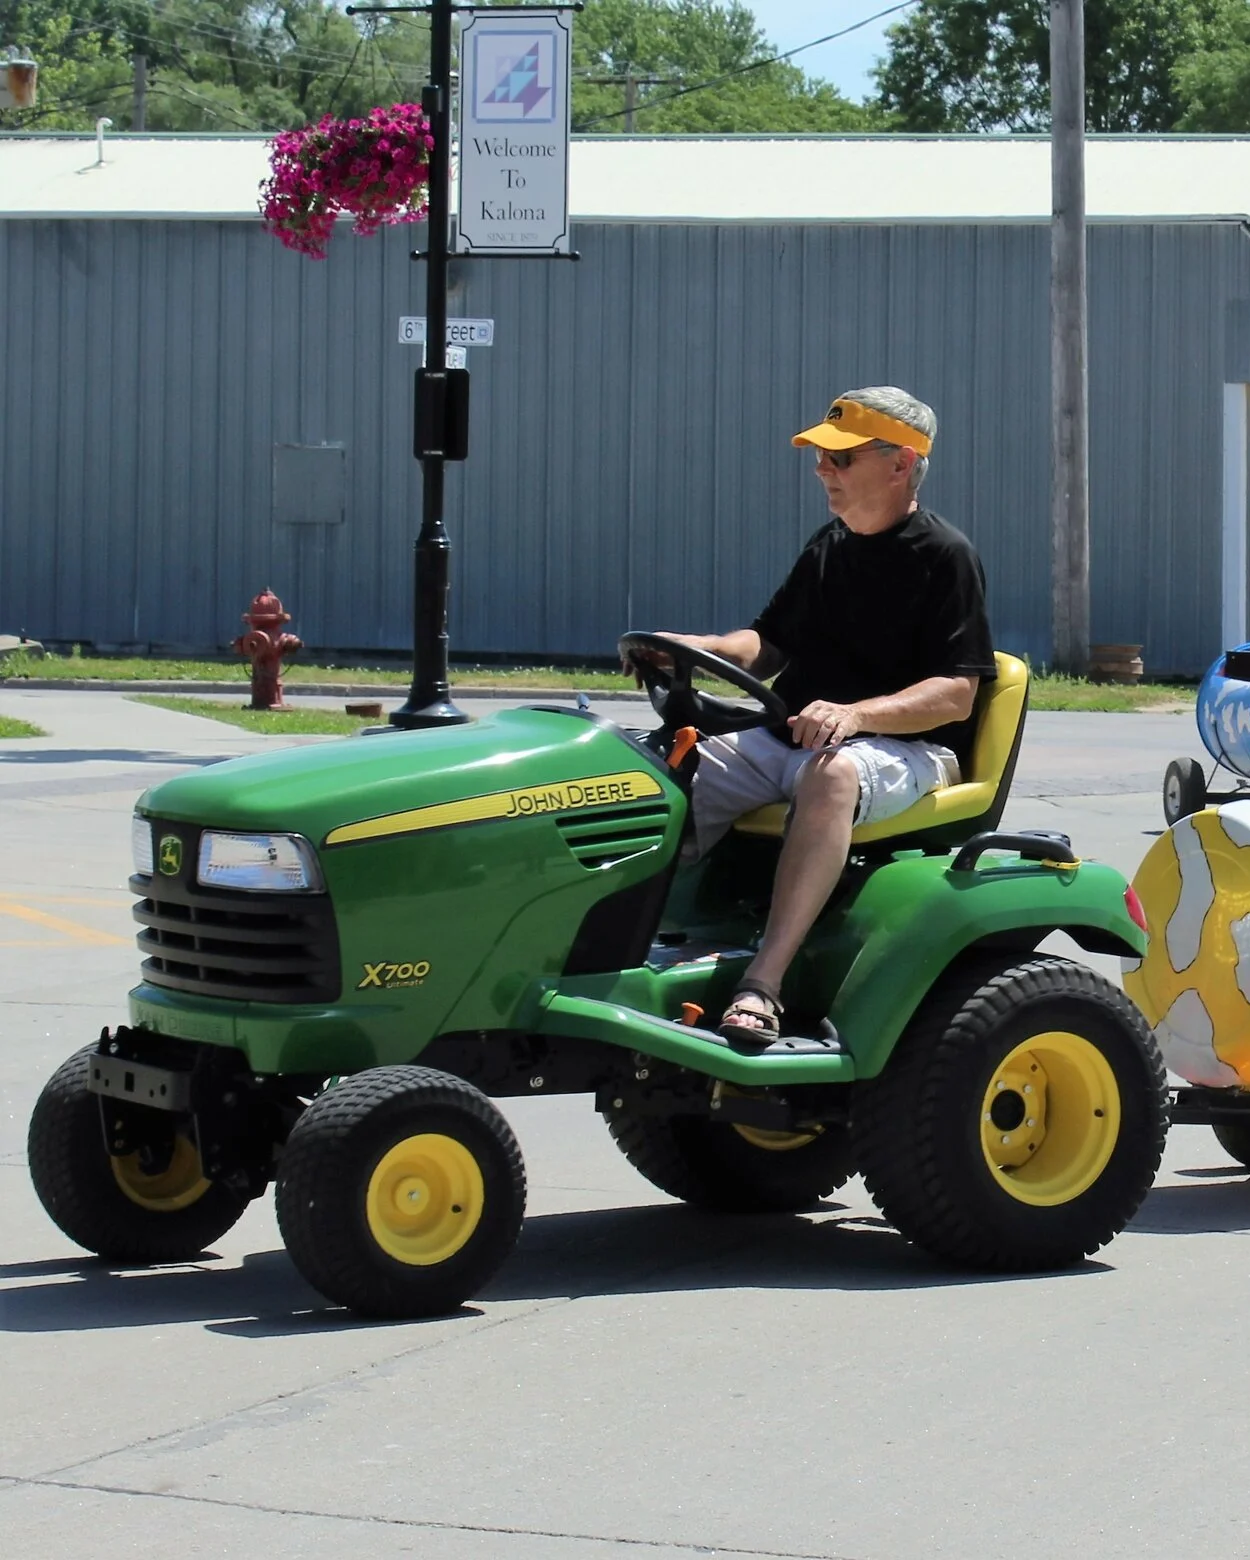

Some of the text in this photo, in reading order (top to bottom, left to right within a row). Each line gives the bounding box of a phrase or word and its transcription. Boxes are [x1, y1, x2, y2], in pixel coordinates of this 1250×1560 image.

[473, 137, 557, 157] Welcome
[500, 168, 526, 189] To
[481, 200, 546, 221] Kalona
[506, 782, 633, 815] JOHN DEERE
[358, 961, 430, 988] X700
